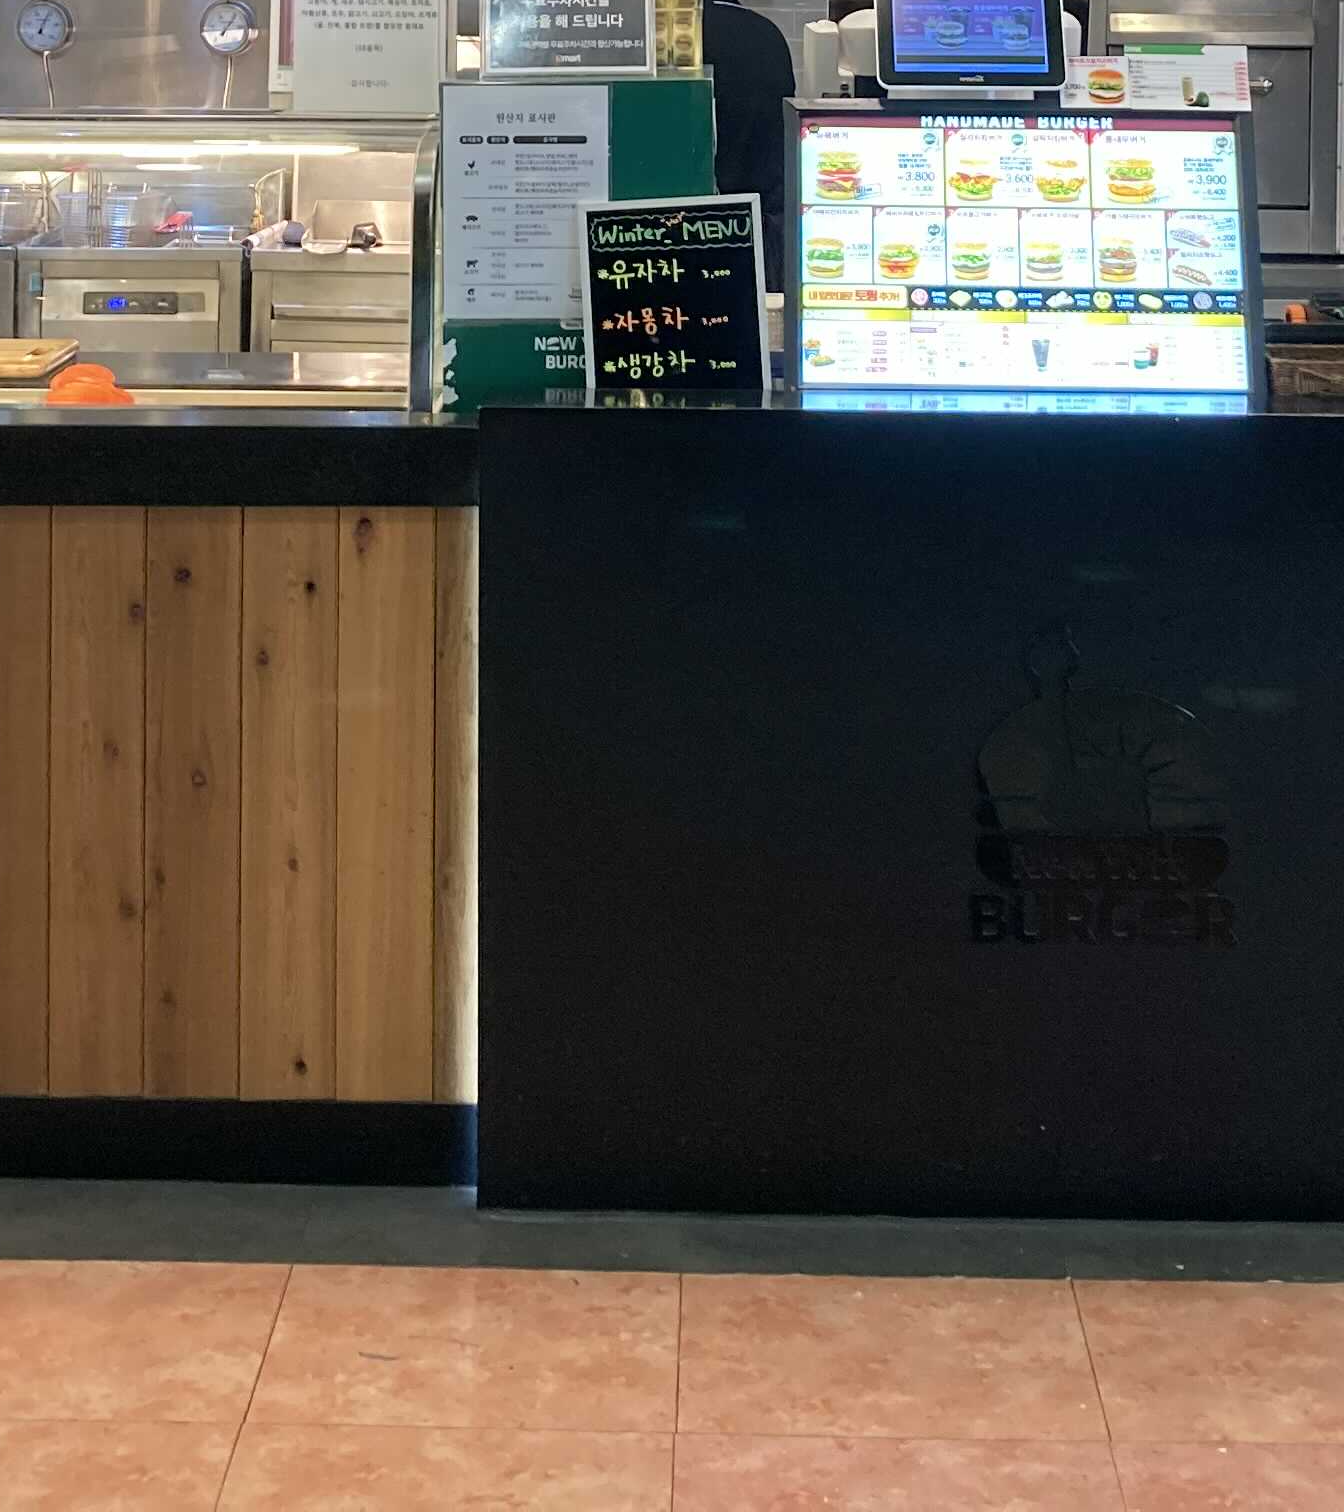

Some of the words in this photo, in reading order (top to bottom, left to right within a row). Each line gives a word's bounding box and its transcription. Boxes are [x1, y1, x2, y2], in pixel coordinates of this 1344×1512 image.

[555, 13, 569, 29] 해
[572, 12, 624, 29] 드립니다
[496, 112, 525, 124] 원산지
[598, 223, 667, 245] Winter
[682, 217, 751, 241] MENU
[608, 258, 685, 289] 유자차
[613, 306, 690, 336] 자몽차
[617, 349, 696, 380] 생강차
